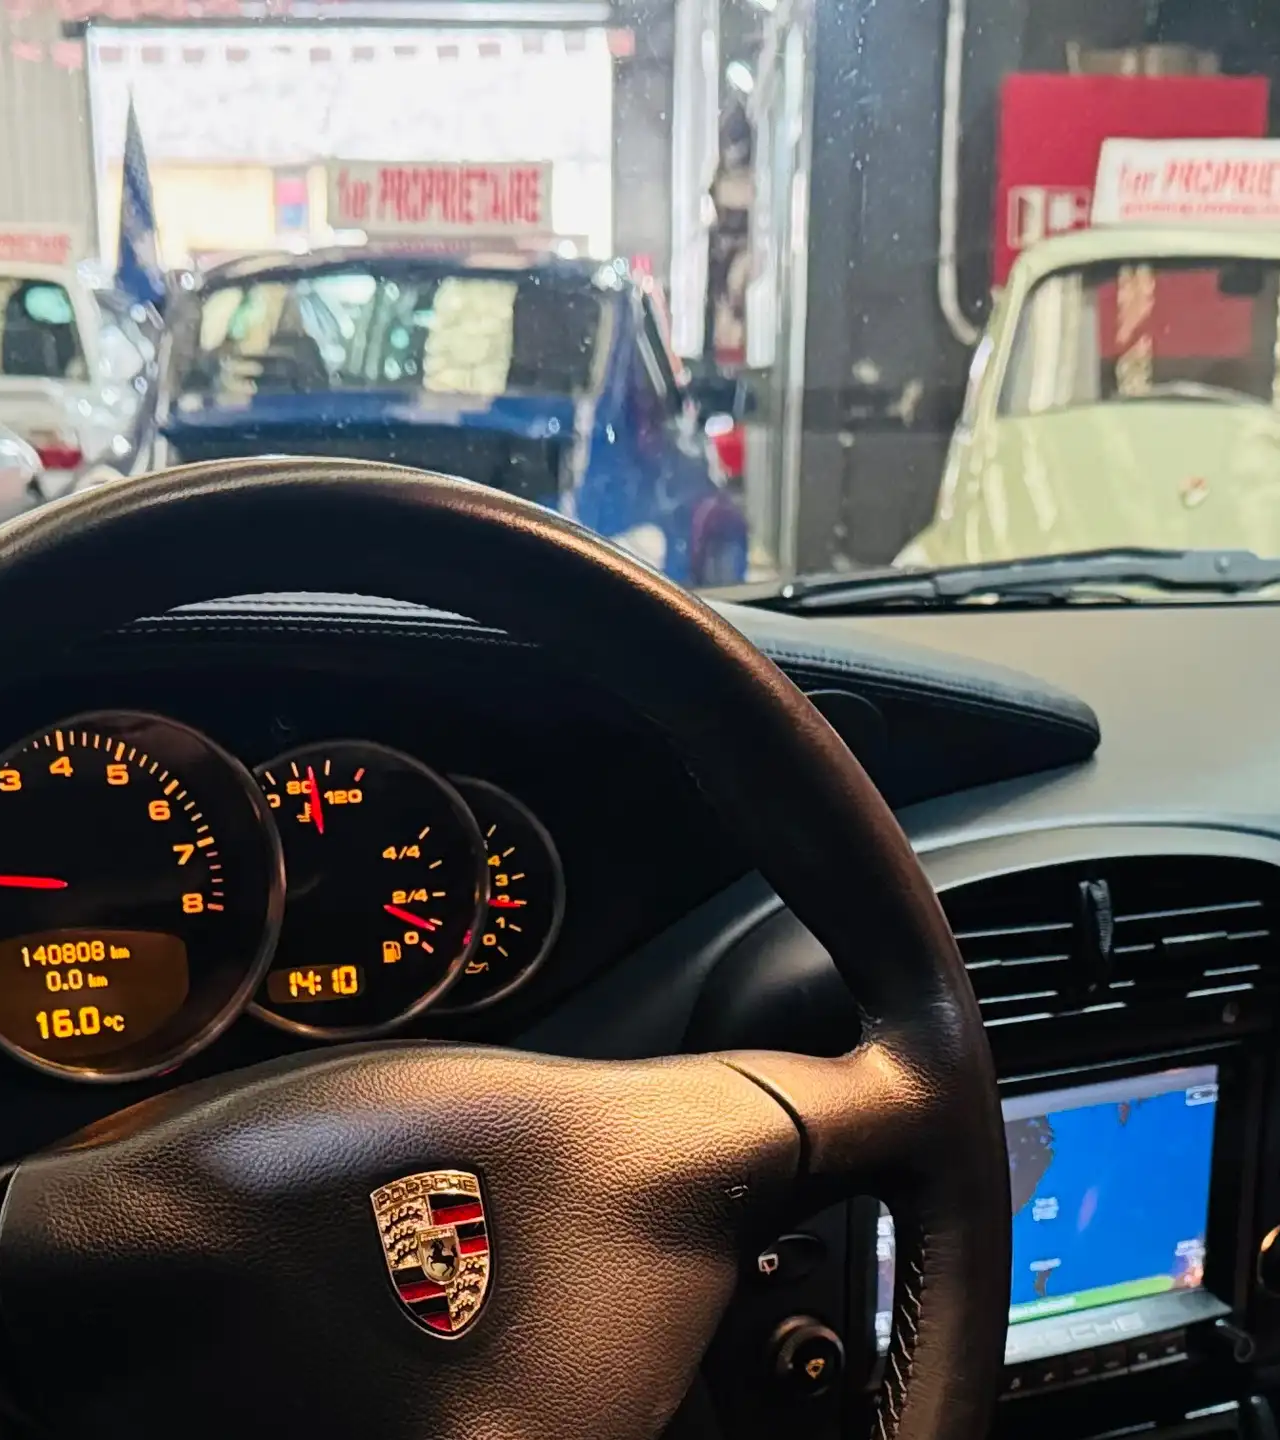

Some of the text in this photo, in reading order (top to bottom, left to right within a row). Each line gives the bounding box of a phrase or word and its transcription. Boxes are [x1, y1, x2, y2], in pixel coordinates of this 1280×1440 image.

[49, 756, 73, 777] 4
[107, 764, 129, 785] 5
[324, 789, 362, 805] 120
[148, 800, 171, 821] 6
[173, 843, 194, 865] 7
[382, 844, 421, 861] 4/4
[495, 874, 508, 887] 3
[182, 893, 204, 914] 8
[392, 888, 428, 904] 2/4
[404, 930, 419, 945] 0
[483, 934, 496, 946] 0
[21, 941, 131, 967] 140808 km
[46, 969, 108, 992] 0.0 km
[289, 965, 358, 997] 14:10
[36, 1006, 101, 1040] 16.0
[375, 1175, 477, 1210] PORSCHE
